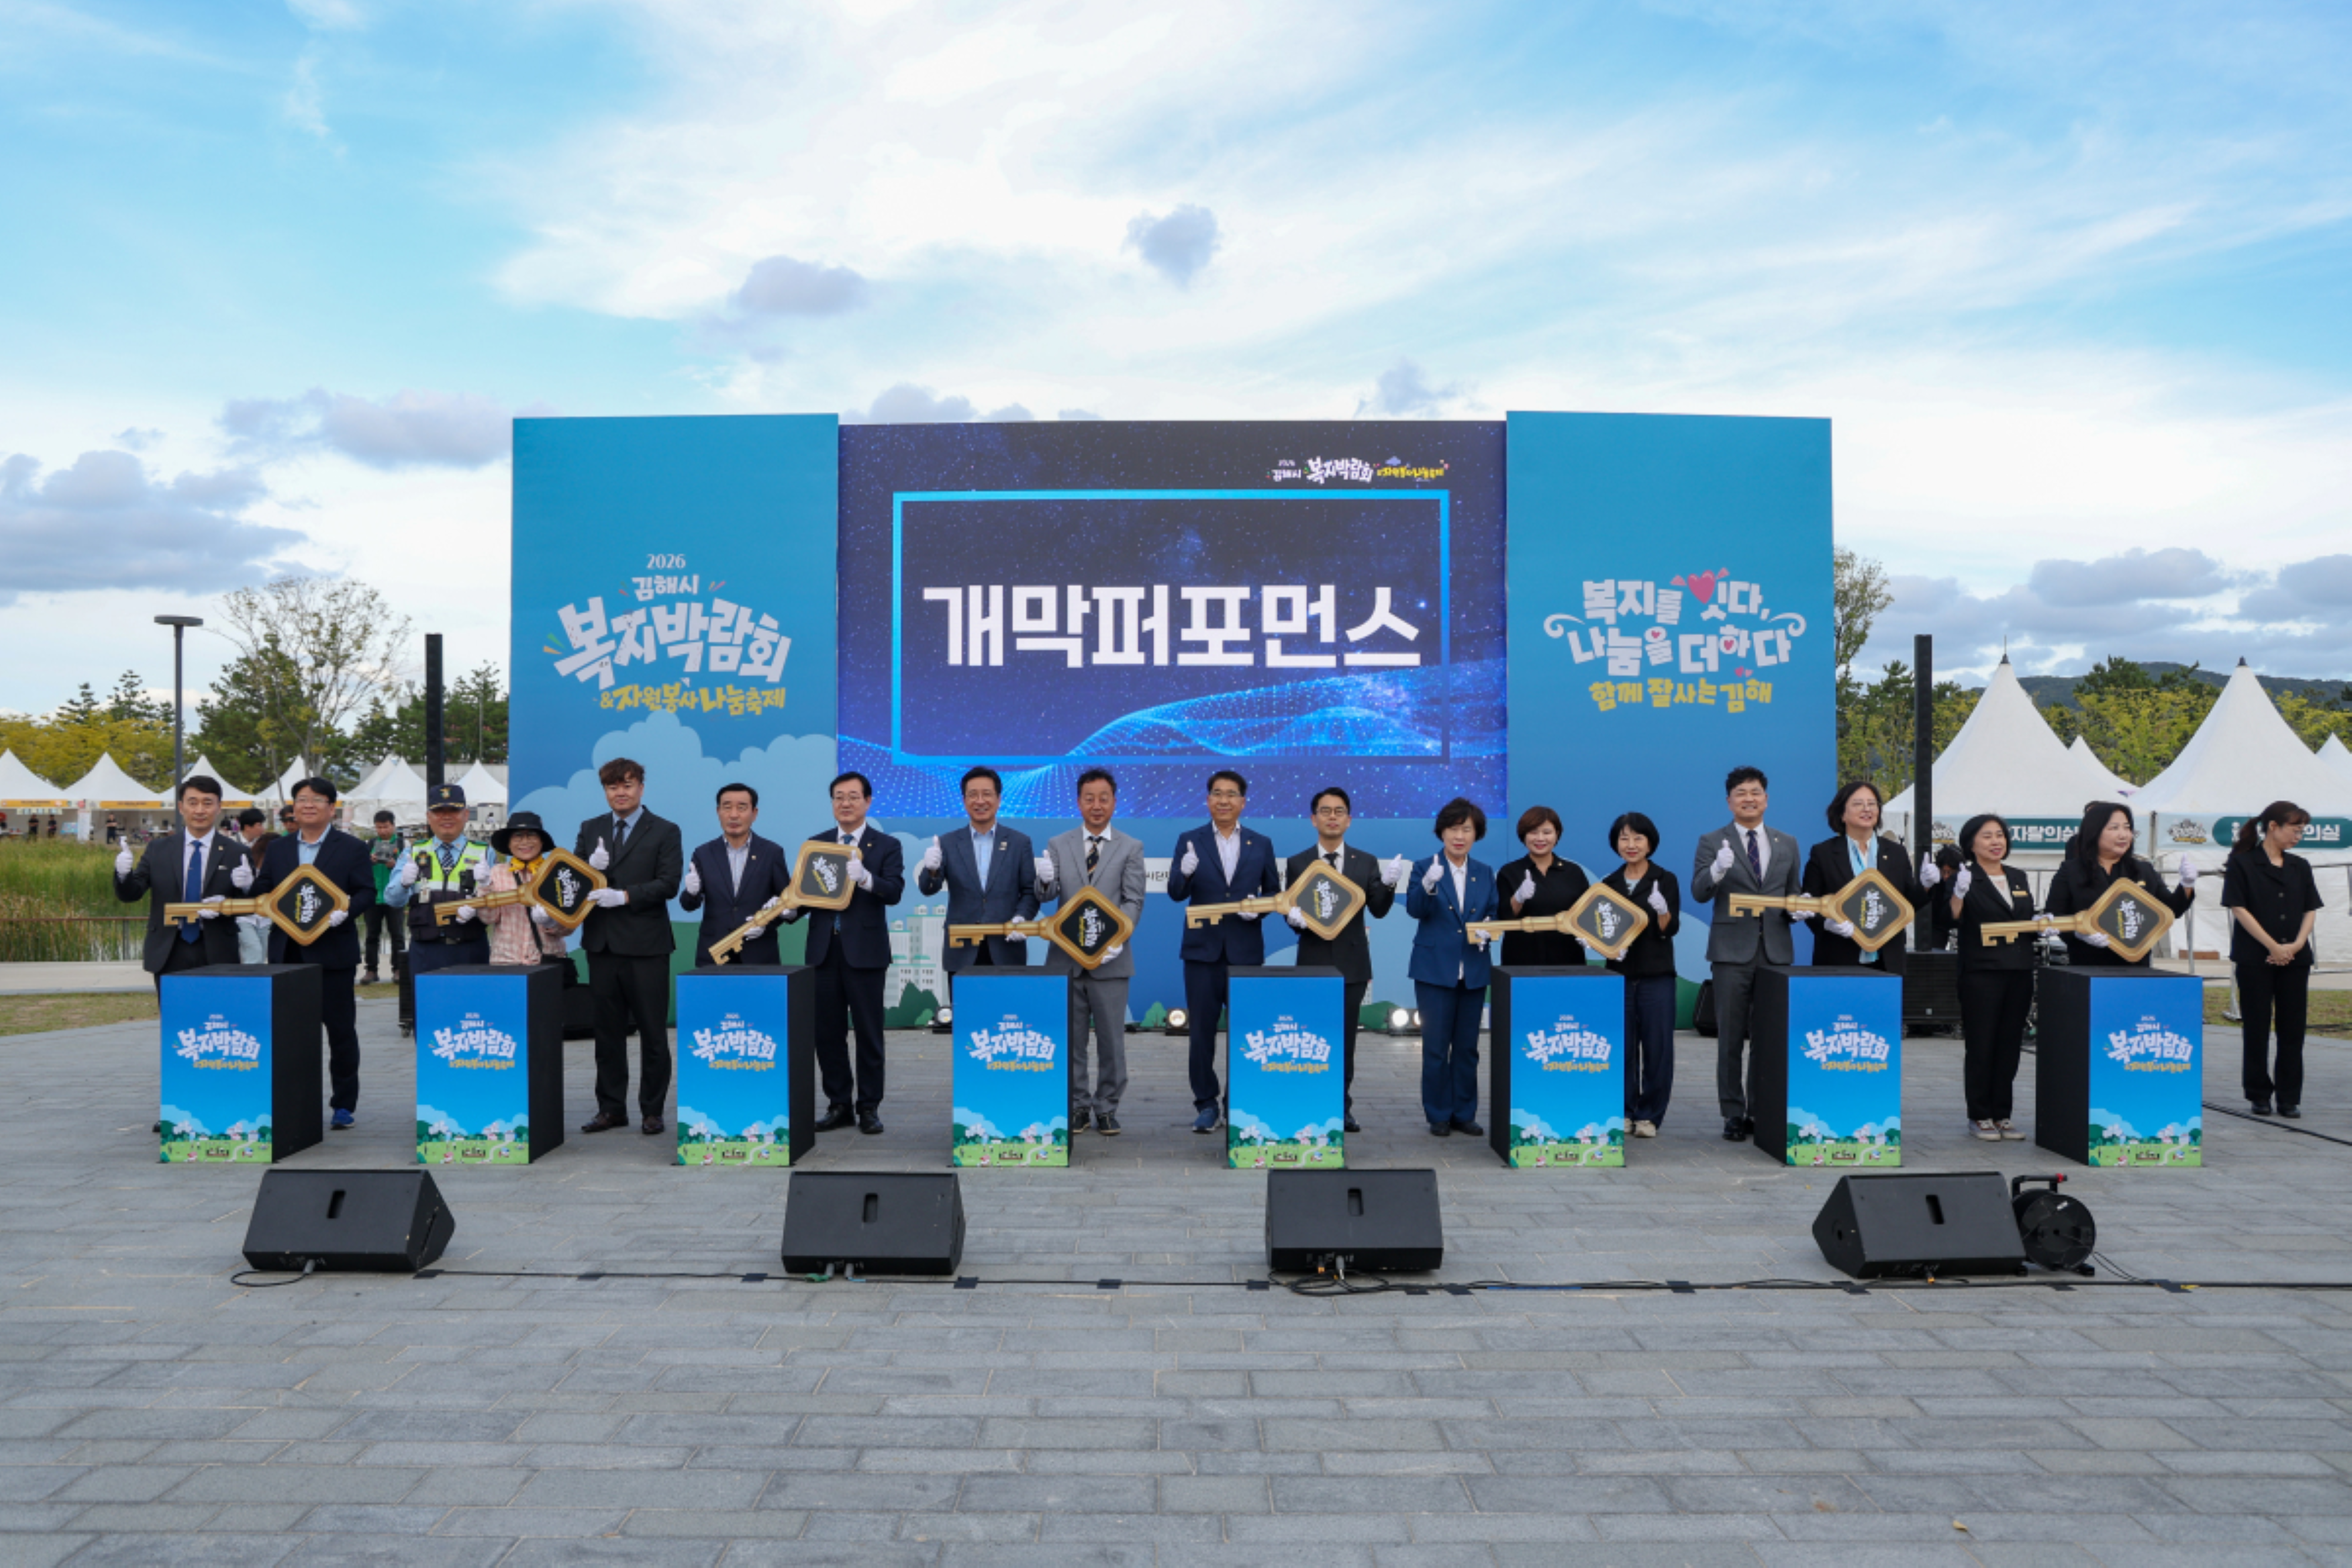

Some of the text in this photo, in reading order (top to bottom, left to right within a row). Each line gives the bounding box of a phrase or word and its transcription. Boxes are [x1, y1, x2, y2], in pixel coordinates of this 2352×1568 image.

[646, 554, 686, 569] 2026
[632, 574, 700, 601] 김해시
[1583, 579, 1683, 625] 복지를
[553, 596, 791, 690] 복지박람회
[923, 584, 1421, 668] 개막퍼포먼스
[1567, 624, 1792, 676] 나눔을 더하다
[1589, 681, 1643, 712] 함께
[1720, 678, 1773, 713] 김해
[177, 1028, 261, 1061] 복지박람회
[432, 1028, 517, 1061] 복지박람회
[692, 1028, 777, 1061] 복지박람회
[969, 1029, 1056, 1062] 복지박람회
[1244, 1030, 1331, 1064] 복지박람회
[1526, 1030, 1612, 1064] 복지박람회
[1804, 1029, 1890, 1062] 복지박람회
[2108, 1030, 2193, 1064] 복지박람회
